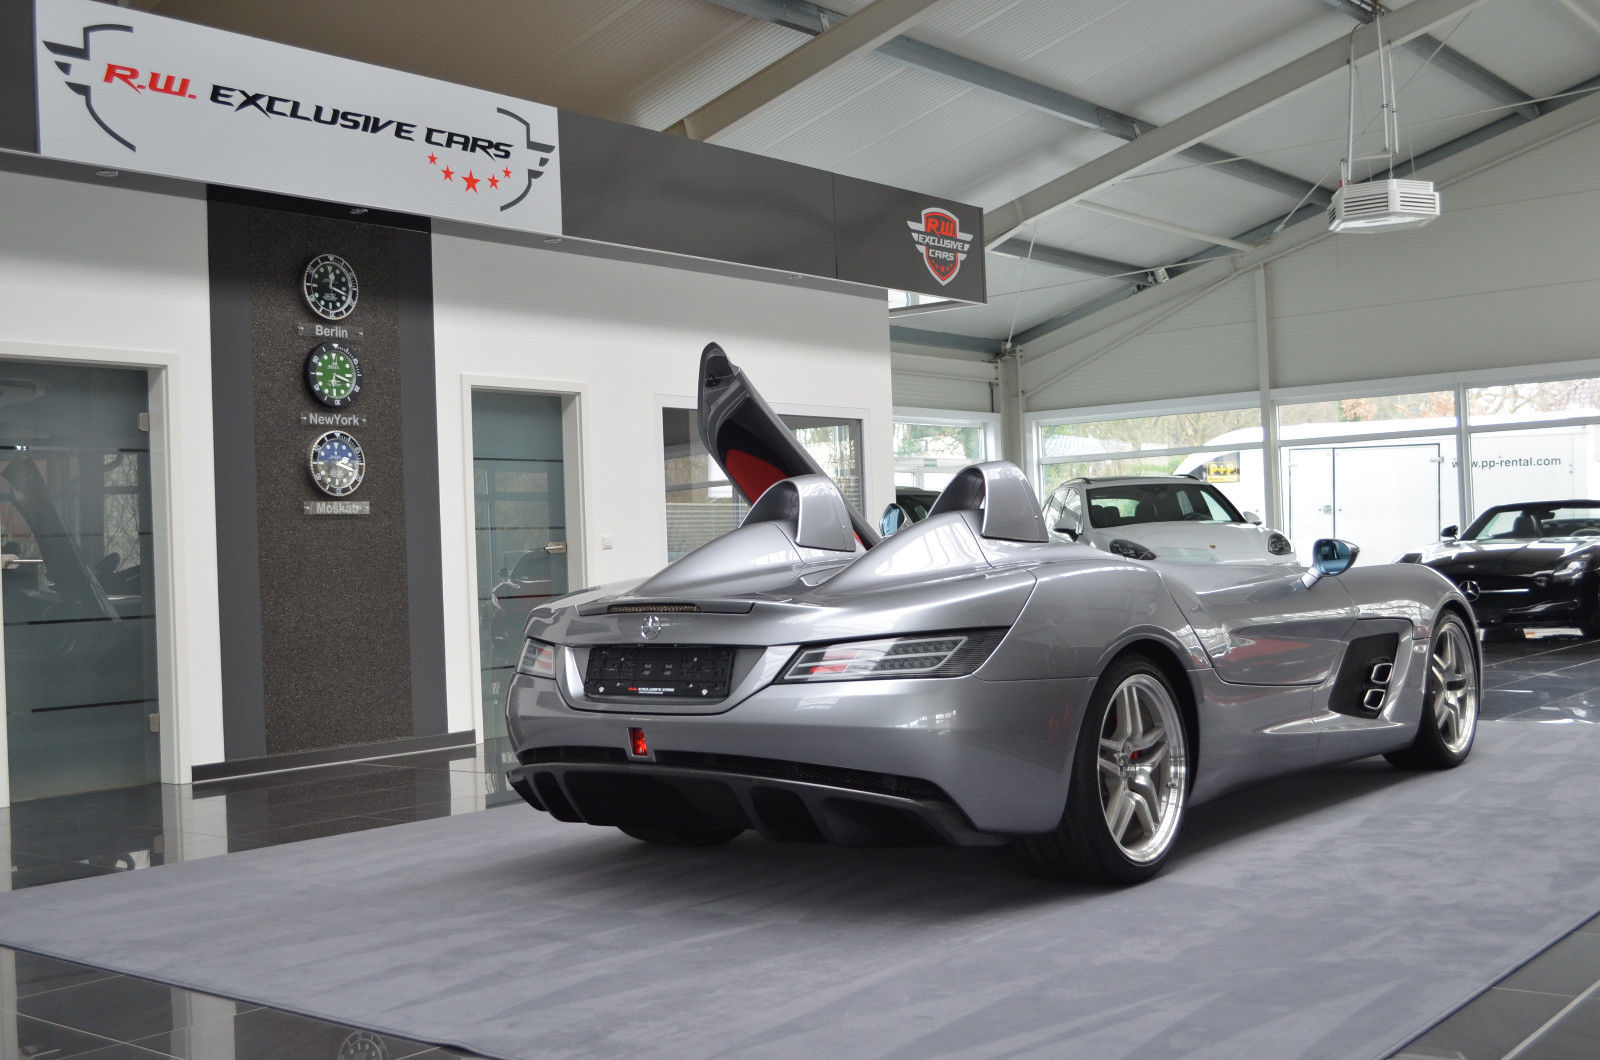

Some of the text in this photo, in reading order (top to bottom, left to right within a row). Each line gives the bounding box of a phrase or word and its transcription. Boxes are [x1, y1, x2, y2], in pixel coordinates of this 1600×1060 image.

[103, 63, 514, 162] R.W. EXCLUSIVE CARS
[919, 233, 964, 251] EXCLUSIVE
[929, 249, 955, 261] CARS
[315, 324, 348, 338] Berlin
[309, 413, 359, 426] NewYork
[1451, 457, 1561, 470] ww.pp-rental.com
